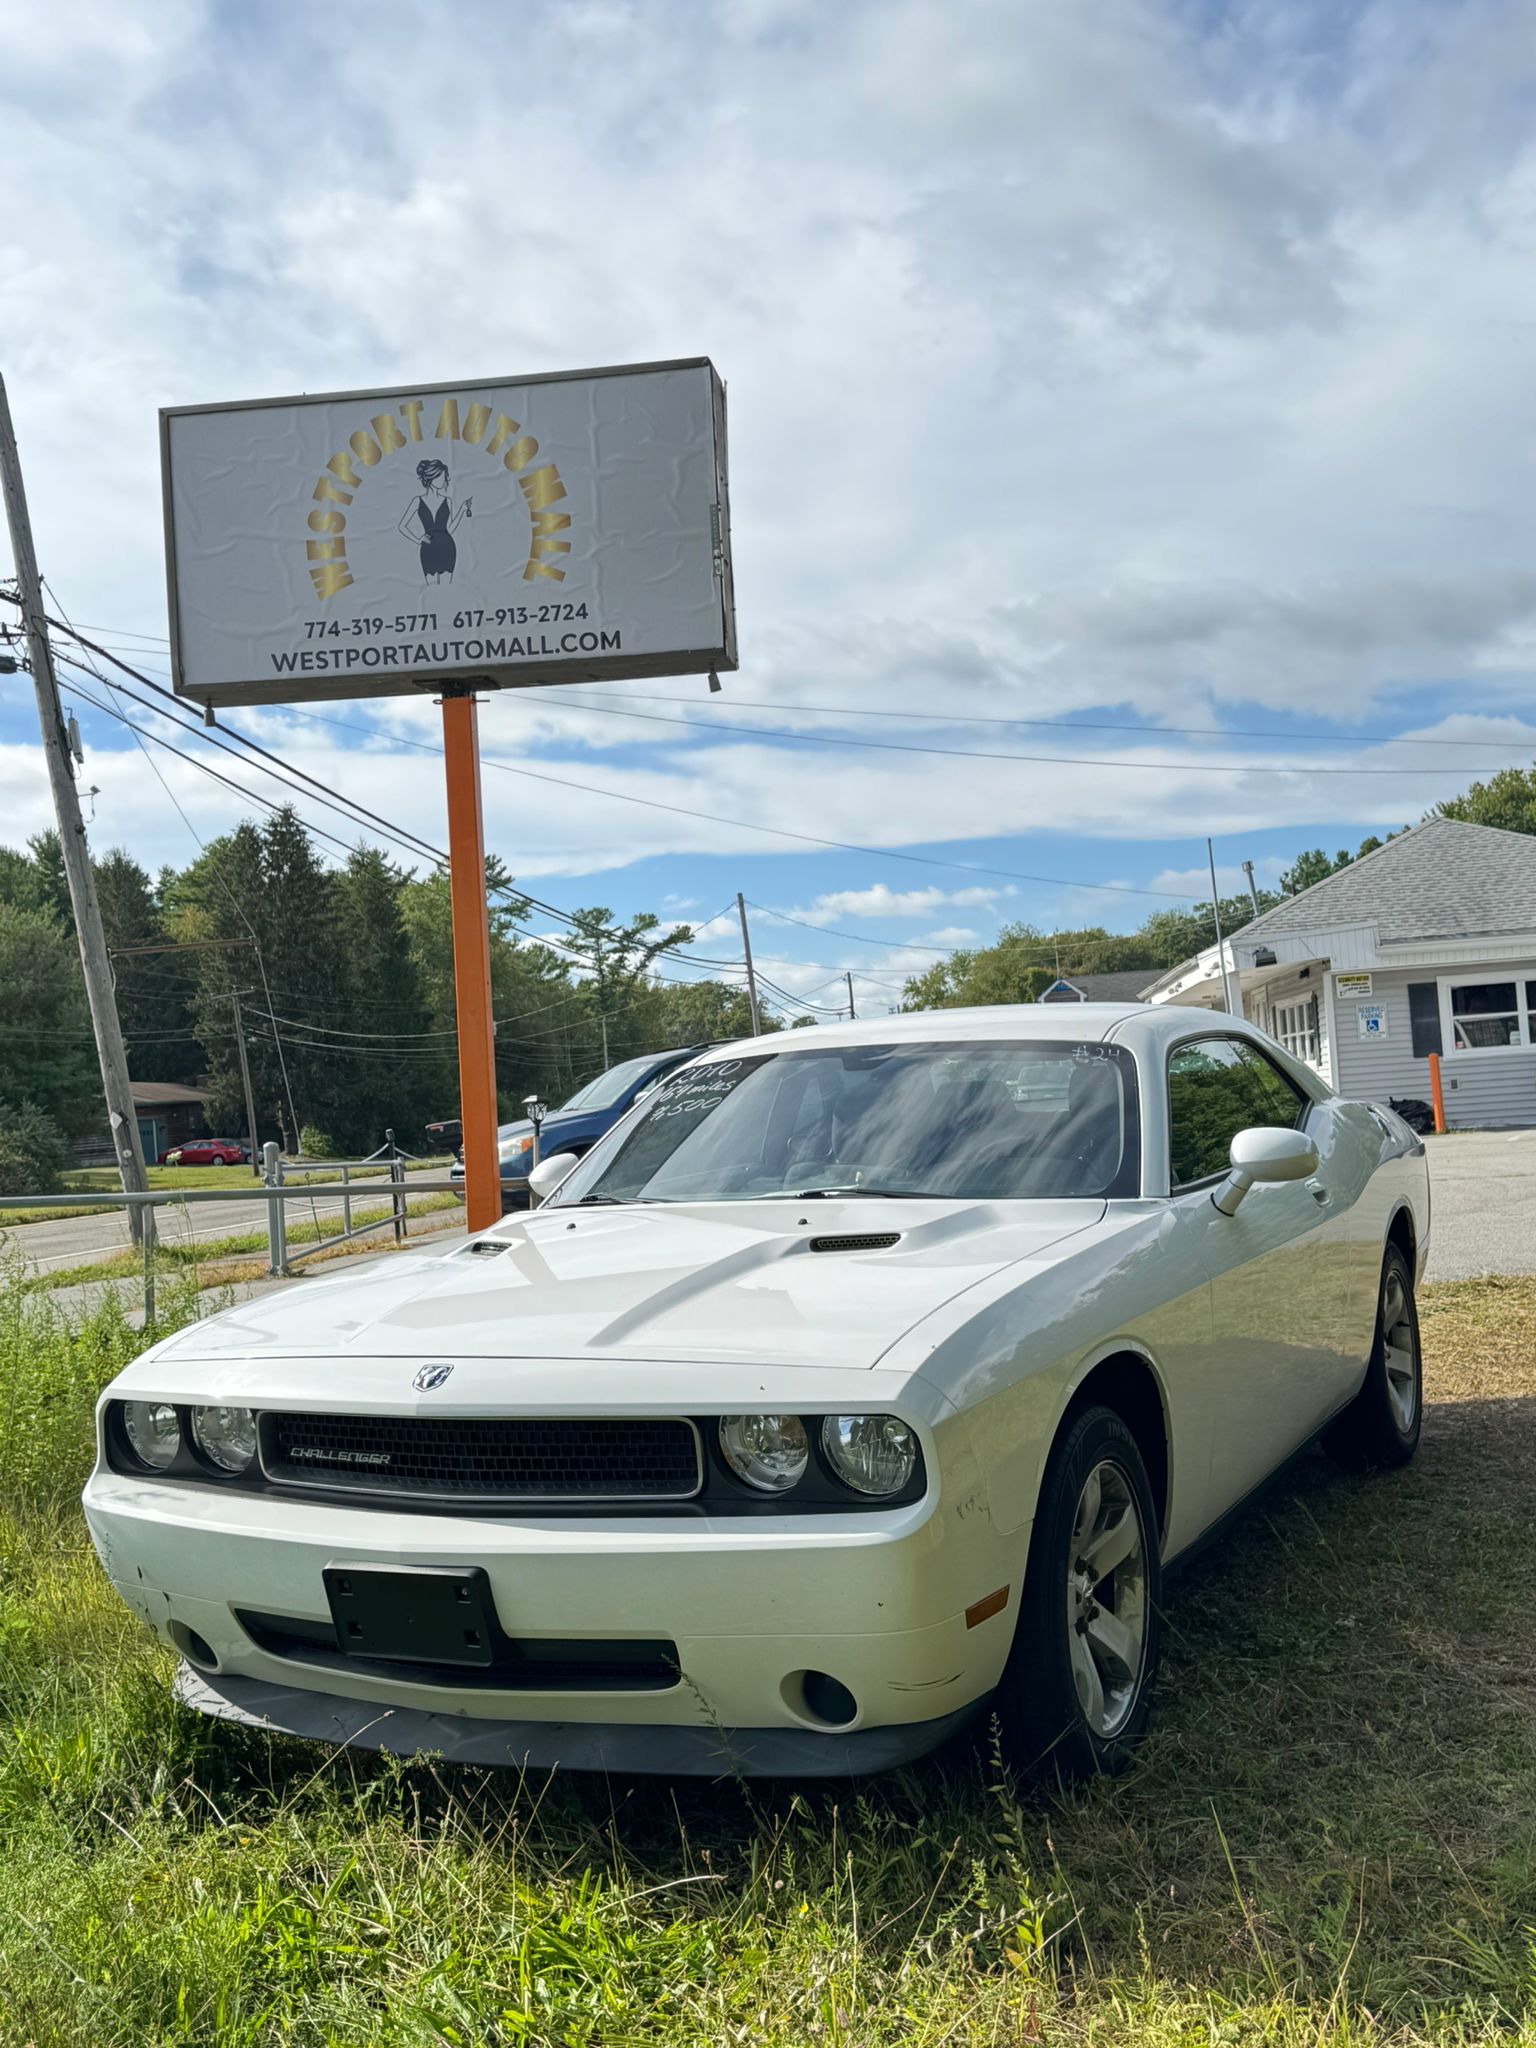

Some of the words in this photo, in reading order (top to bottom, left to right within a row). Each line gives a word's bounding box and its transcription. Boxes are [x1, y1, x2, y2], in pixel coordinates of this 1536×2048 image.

[306, 400, 425, 601] WESTPORT
[434, 399, 571, 583] AUTOMALL
[304, 613, 438, 639] 774-319-5771
[452, 602, 589, 629] 617-913-2724
[271, 630, 622, 673] WESTPORTAUTOMALL.COM
[1361, 1012, 1383, 1020] PARKING
[669, 1060, 743, 1087] 2010
[290, 1447, 391, 1464] CHALLENGER
